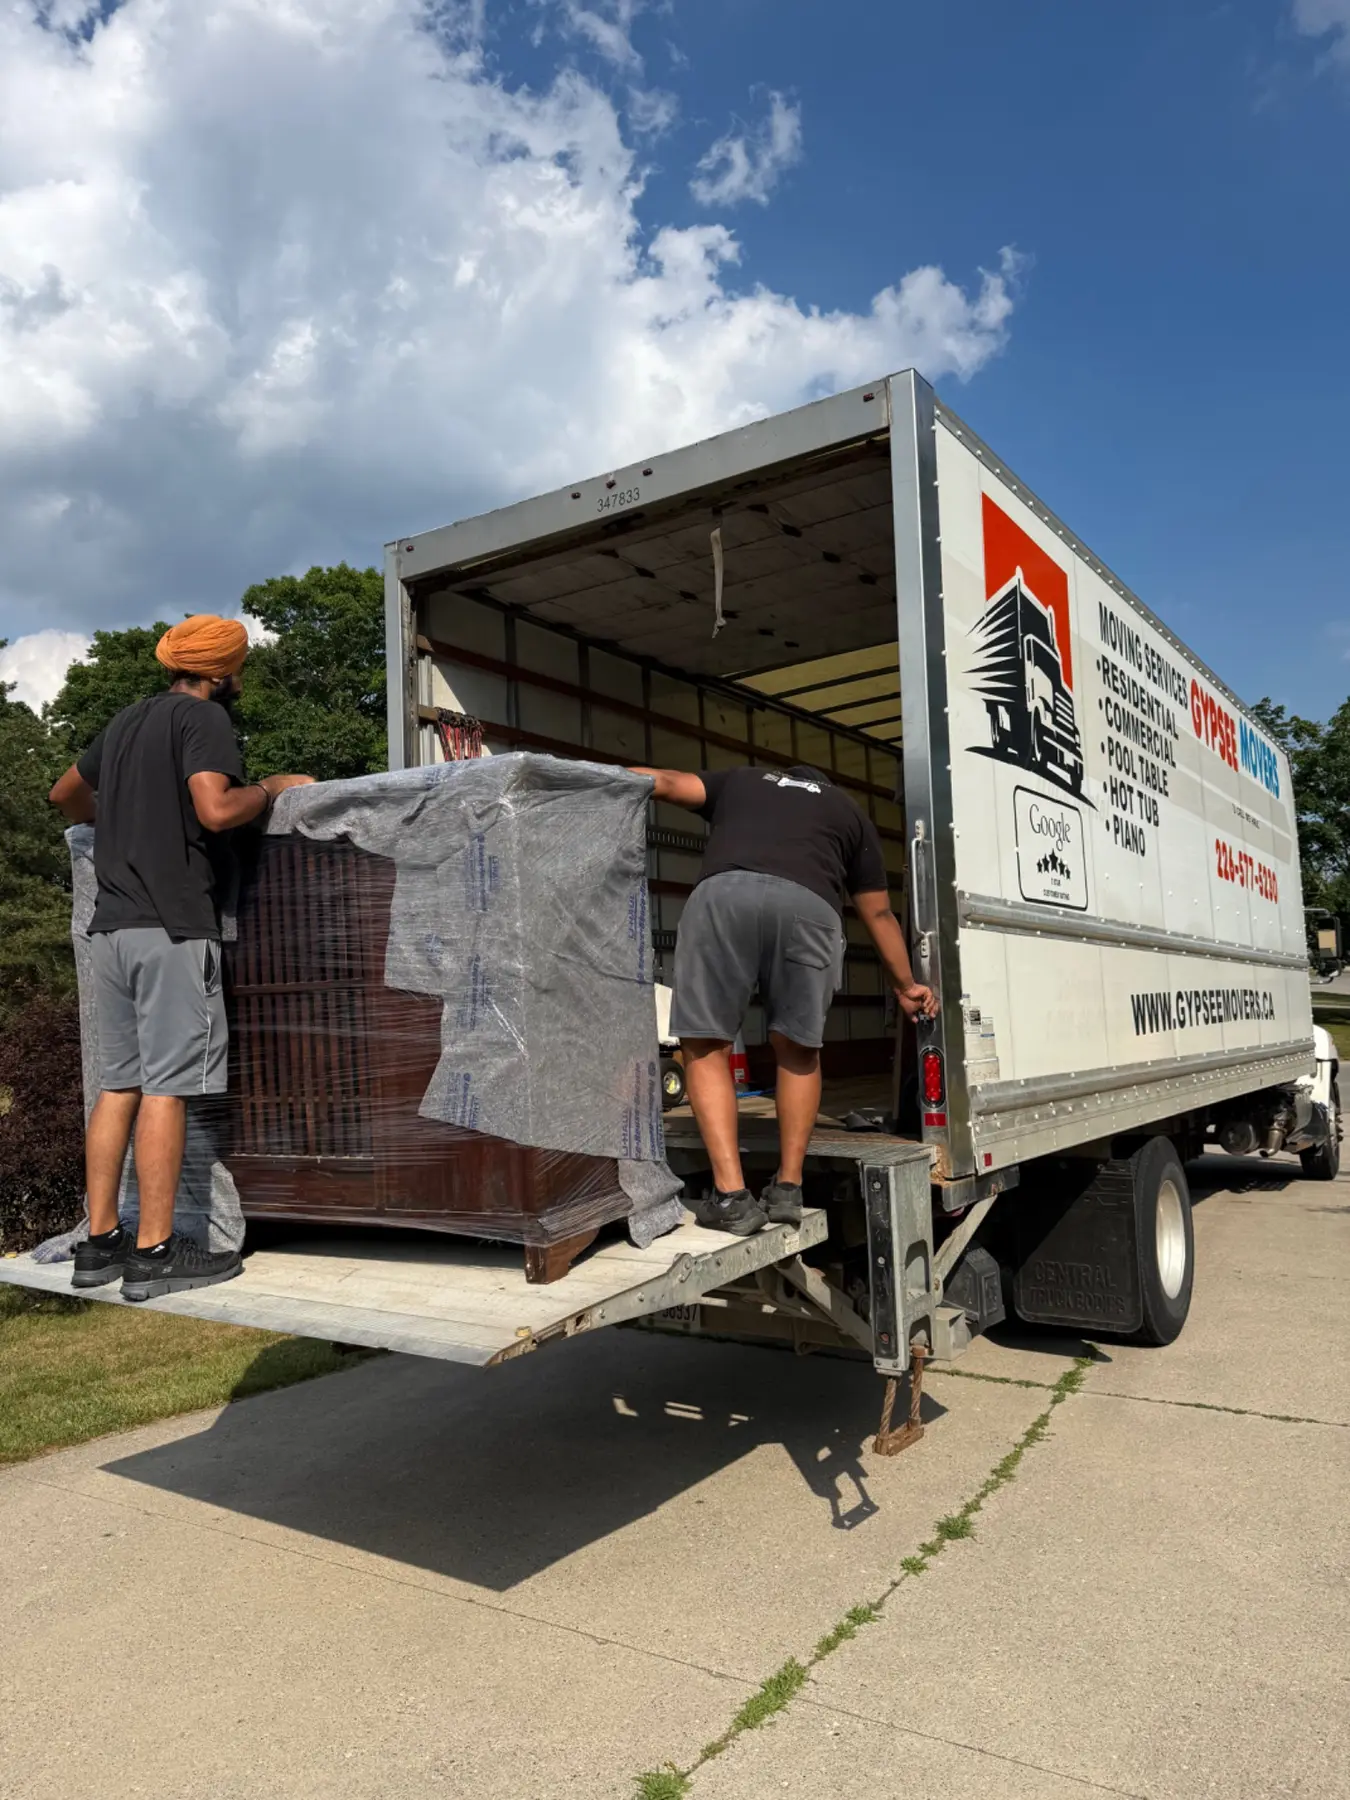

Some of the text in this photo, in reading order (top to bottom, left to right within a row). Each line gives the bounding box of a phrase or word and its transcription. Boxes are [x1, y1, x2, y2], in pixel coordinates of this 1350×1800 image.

[597, 487, 640, 513] 347833
[1098, 600, 1188, 710] MOVING SERVICES
[1102, 654, 1179, 741] RESIDENTIAL
[1105, 696, 1177, 769] COMMERCIAL
[1190, 678, 1280, 800] GYPSEE MOVERS
[1107, 735, 1169, 798] POOL TABLE
[1109, 774, 1160, 828] HOT TUB
[1029, 803, 1072, 852] Google
[1113, 813, 1146, 858] PIANO
[1130, 988, 1276, 1037] WWW.GYPSEEMOVERS.CA
[1029, 1286, 1126, 1314] TRUCK BODIES
[1034, 1260, 1117, 1289] CENTRAL
